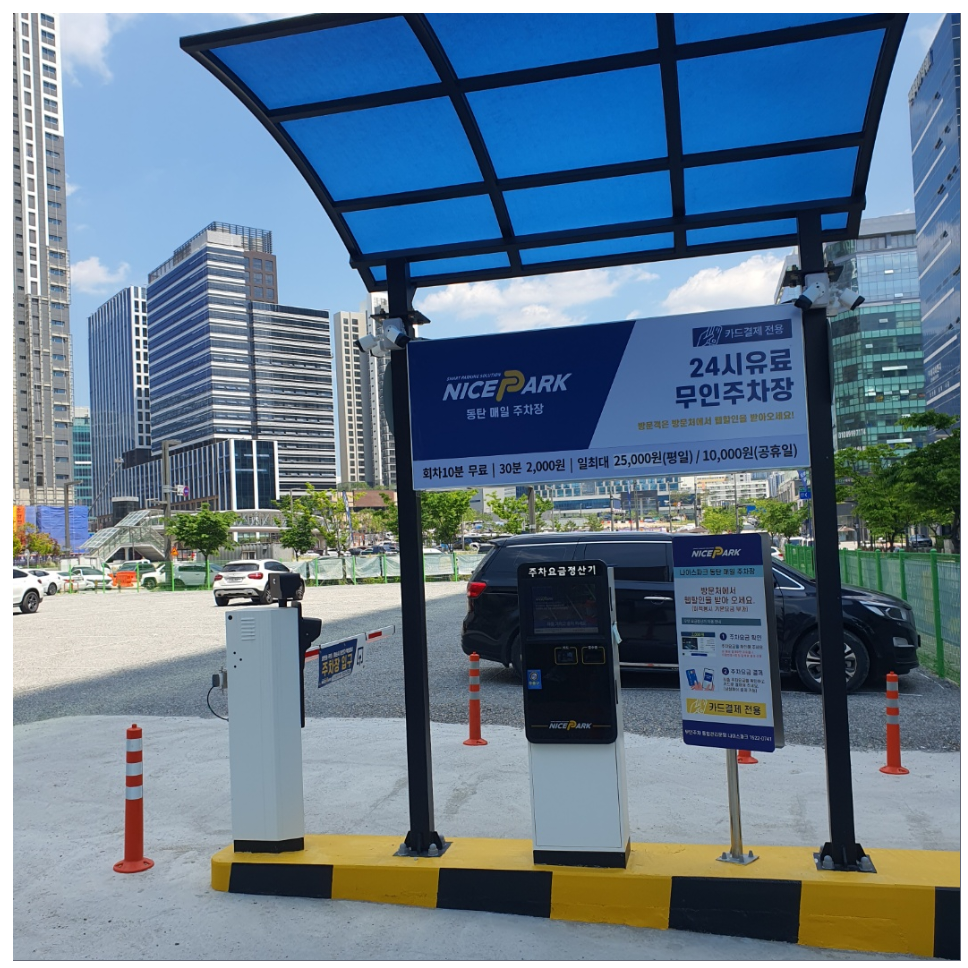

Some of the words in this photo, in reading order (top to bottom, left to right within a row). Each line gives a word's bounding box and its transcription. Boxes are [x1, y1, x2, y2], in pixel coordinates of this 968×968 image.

[725, 325, 763, 339] 카드결제
[764, 323, 784, 336] 전용
[689, 349, 792, 378] 24시유료
[442, 370, 572, 402] NICEPARK
[675, 377, 795, 409] 무인주차장
[466, 408, 487, 420] 동탄
[489, 406, 510, 418] 매일
[513, 403, 545, 416] 주차장
[422, 466, 464, 480] 회차10분
[468, 464, 489, 478] 무료
[499, 461, 522, 475] 30분
[526, 458, 566, 475] 2,000원
[577, 455, 610, 471] 일최대
[613, 449, 693, 468] 25,000원(평일)
[702, 443, 798, 463] 10,000원(공휴일)
[691, 546, 742, 559] NICEPARK
[528, 565, 596, 578] 주차요금정산기
[737, 567, 755, 575] 주차장
[700, 586, 737, 595] 방문처에서
[714, 596, 729, 605] 받아
[321, 657, 340, 677] 주차장
[341, 653, 353, 670] 입구
[709, 702, 742, 714] 카드결제
[744, 706, 761, 716] 전용
[549, 720, 592, 731] NICEPARK
